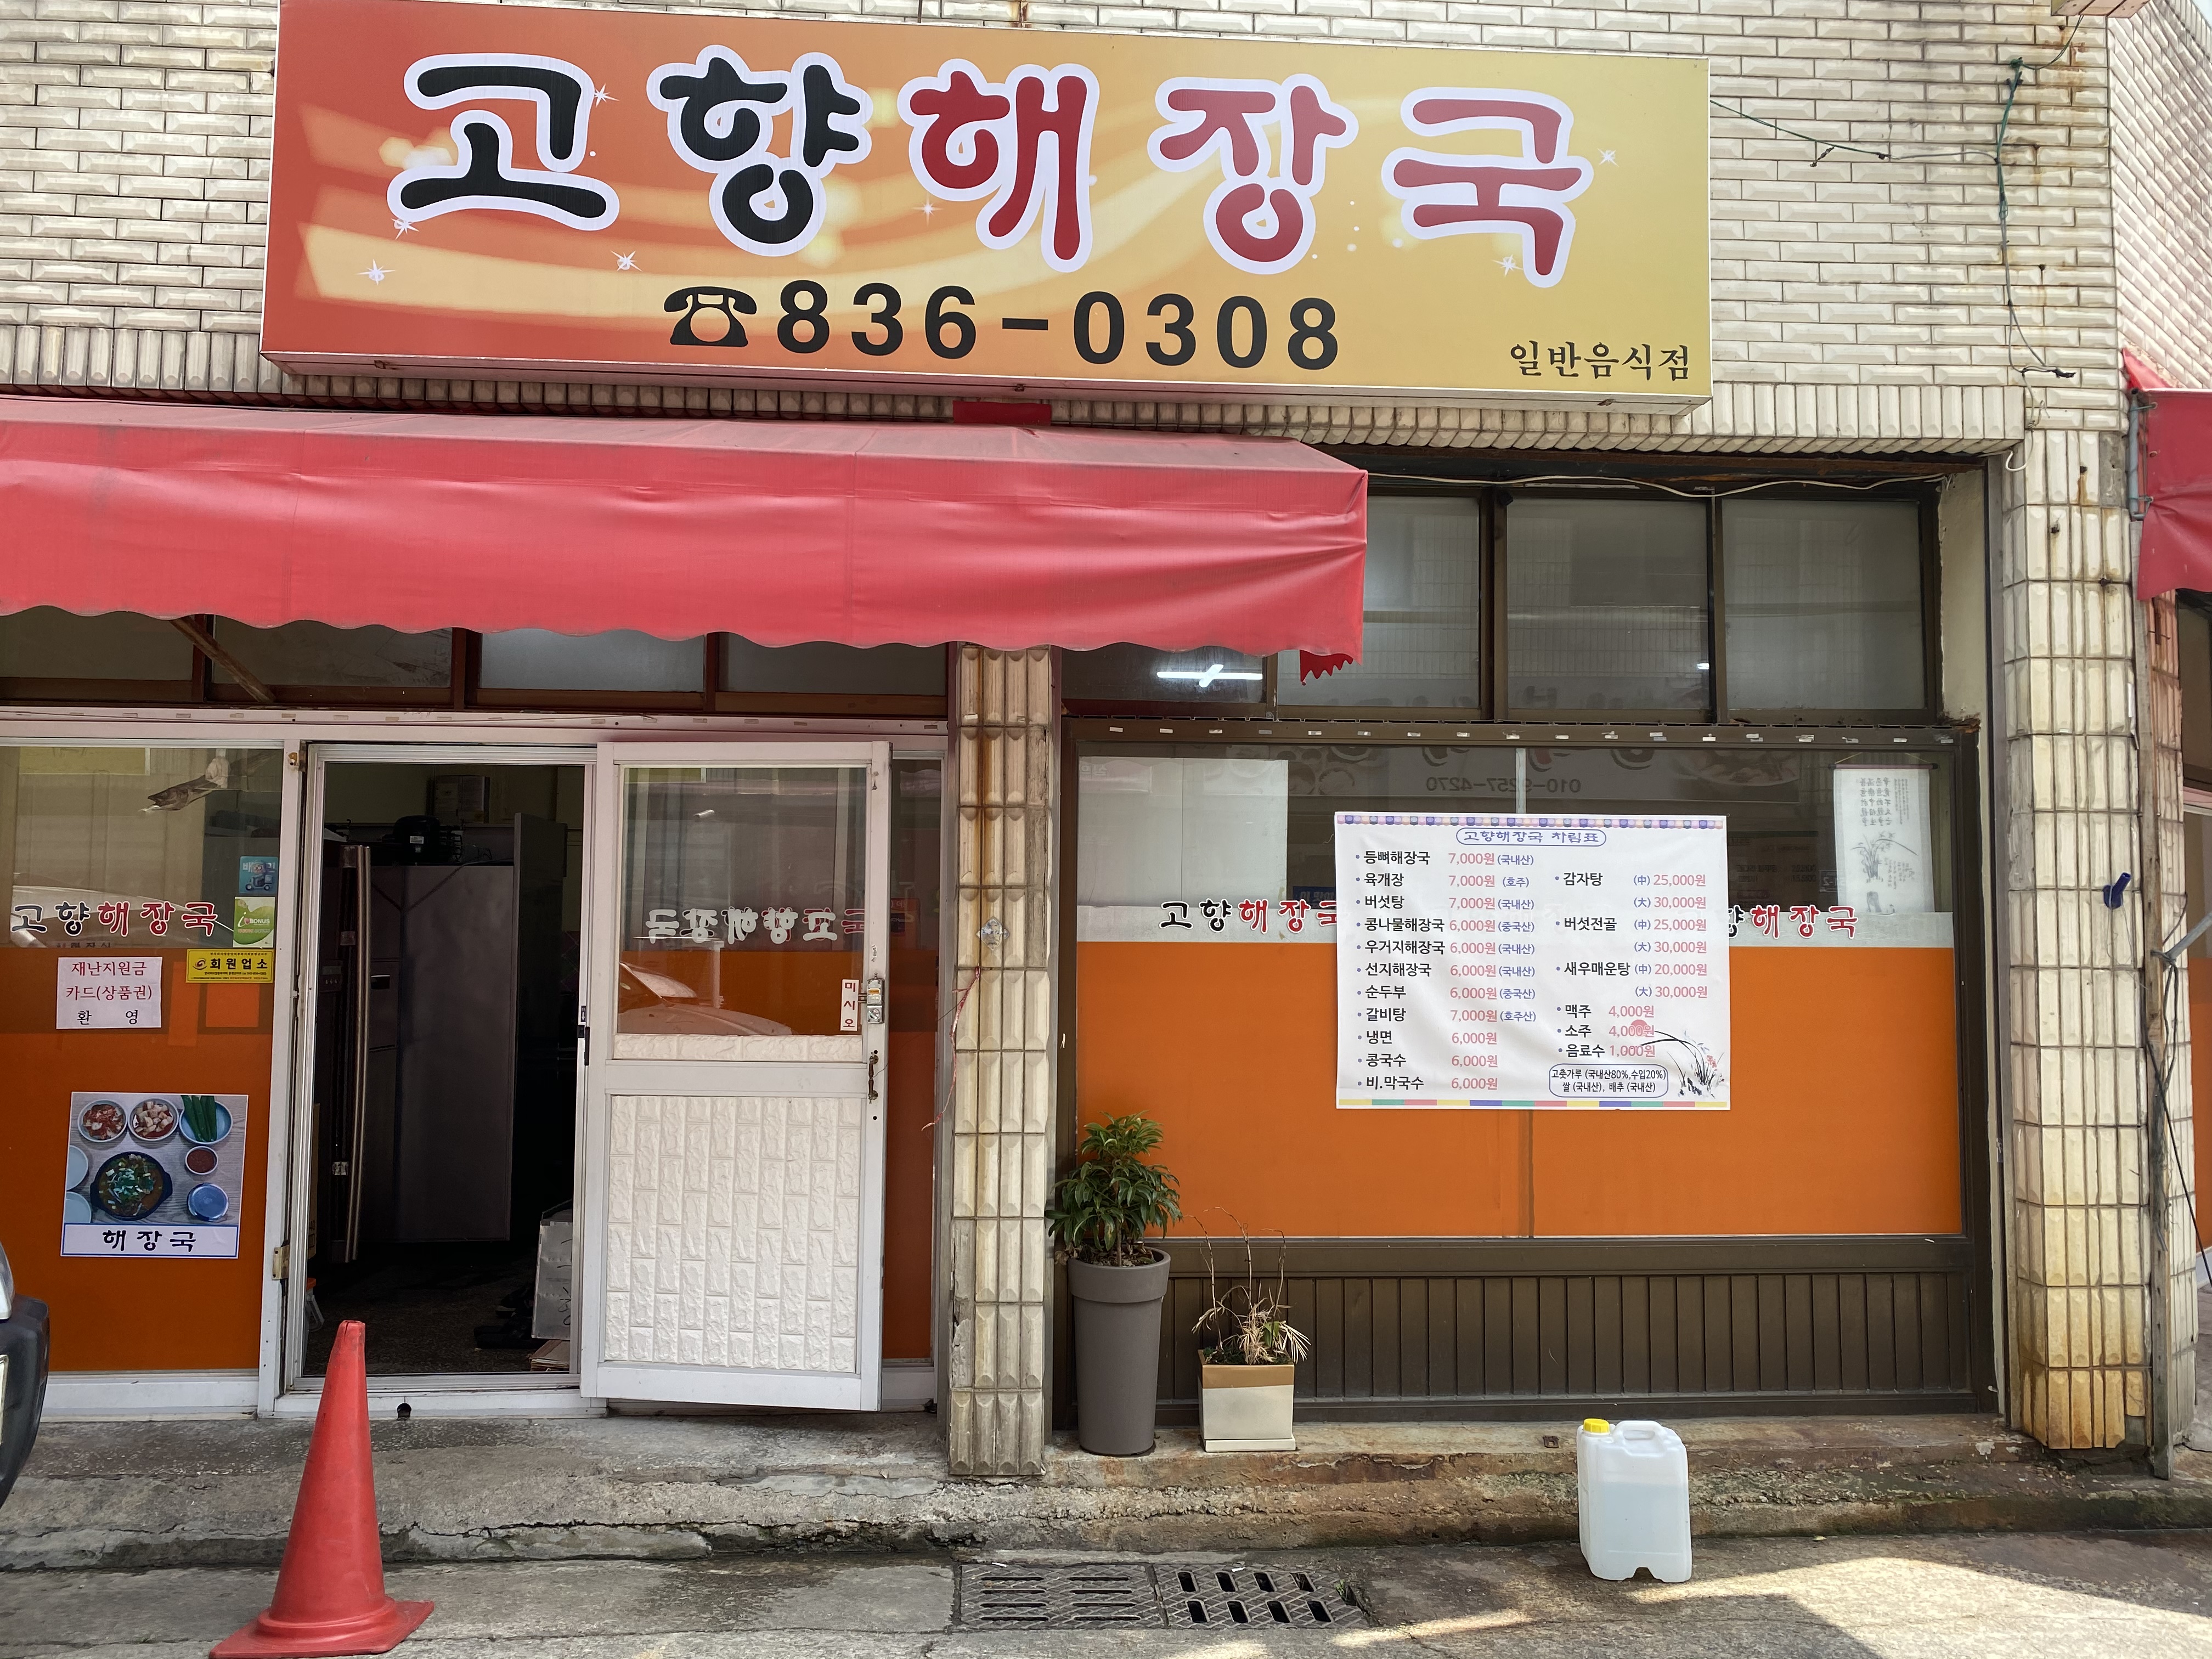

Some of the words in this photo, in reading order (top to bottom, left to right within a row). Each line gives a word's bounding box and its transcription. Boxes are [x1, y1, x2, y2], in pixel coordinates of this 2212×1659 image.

[390, 47, 1591, 285] 고향해장국
[777, 279, 1339, 371] 836-0308
[1510, 340, 1689, 381] 일반음식점
[1463, 831, 1543, 843] 고향해장국
[1551, 832, 1599, 843] 차림표
[1364, 851, 1430, 865] 등뼈해장국
[1449, 853, 1494, 865] 7,000원
[1498, 855, 1533, 865] (국내산)
[1364, 873, 1404, 887] 육개장
[1449, 876, 1494, 887] 7,000원
[1503, 877, 1529, 888] (호주)
[1564, 872, 1603, 886] 감자탕
[1634, 875, 1650, 885] (中)
[1654, 874, 1706, 887] 25,000원
[1365, 895, 1404, 909] 버섯탕
[1449, 898, 1495, 910] 7,000원
[1498, 899, 1534, 910] (국내산)
[1634, 898, 1651, 908] (大)
[1654, 897, 1706, 909] 30,000원
[11, 901, 218, 937] 고향해장국
[1364, 918, 1444, 932] 콩나물해장국
[1450, 920, 1495, 932] 6,000원
[1498, 922, 1534, 932] (중국산)
[1565, 917, 1617, 931] 버섯전골
[1634, 919, 1651, 930] (中)
[1654, 919, 1706, 931] 25,000원
[1365, 940, 1445, 955] 우거지해장국
[1451, 943, 1496, 954] 6,000원
[1498, 944, 1534, 955] (국내산)
[1634, 942, 1651, 952] (大)
[1655, 941, 1706, 953] 30,000원
[71, 961, 147, 977] 재난지원금
[210, 958, 268, 970] 회원업소
[1365, 963, 1431, 977] 선지해장국
[1451, 965, 1496, 977] 6,000원
[1499, 966, 1534, 977] (국내산)
[1564, 962, 1630, 976] 새우매운탕
[1635, 964, 1651, 974] (中)
[1655, 964, 1707, 975] 20,000원
[66, 985, 153, 1001] 카드(상품권)
[1365, 985, 1406, 999] 순두부
[1451, 988, 1497, 1000] 6,000원
[1500, 989, 1535, 999] (중국산)
[1635, 986, 1652, 997] (大)
[1656, 986, 1707, 998] 30,000원
[843, 982, 856, 1028] 미시오
[1565, 1005, 1592, 1018] 맥주
[1609, 1006, 1654, 1018] 4,000원
[1367, 1008, 1406, 1022] 갈비탕
[1451, 1010, 1497, 1022] 7,000원
[1500, 1011, 1536, 1022] (호주산)
[1367, 1030, 1392, 1044] 냉면
[1452, 1032, 1497, 1045] 6,000원
[1565, 1025, 1592, 1037] 소주
[1609, 1024, 1656, 1037] 4,000원
[1566, 1044, 1605, 1058] 음료수
[1610, 1044, 1655, 1057] 1,000원
[1366, 1053, 1406, 1067] 콩국수
[1452, 1056, 1497, 1067] 6,000원
[1551, 1068, 1583, 1080] 고춧가루
[1367, 1076, 1424, 1090] 비.막국수
[1452, 1078, 1497, 1090] 6,000원
[1562, 1082, 1570, 1092] 쌀
[1609, 1082, 1624, 1092] 배추
[1627, 1082, 1655, 1092] (국내산)
[102, 1229, 196, 1252] 해장국
